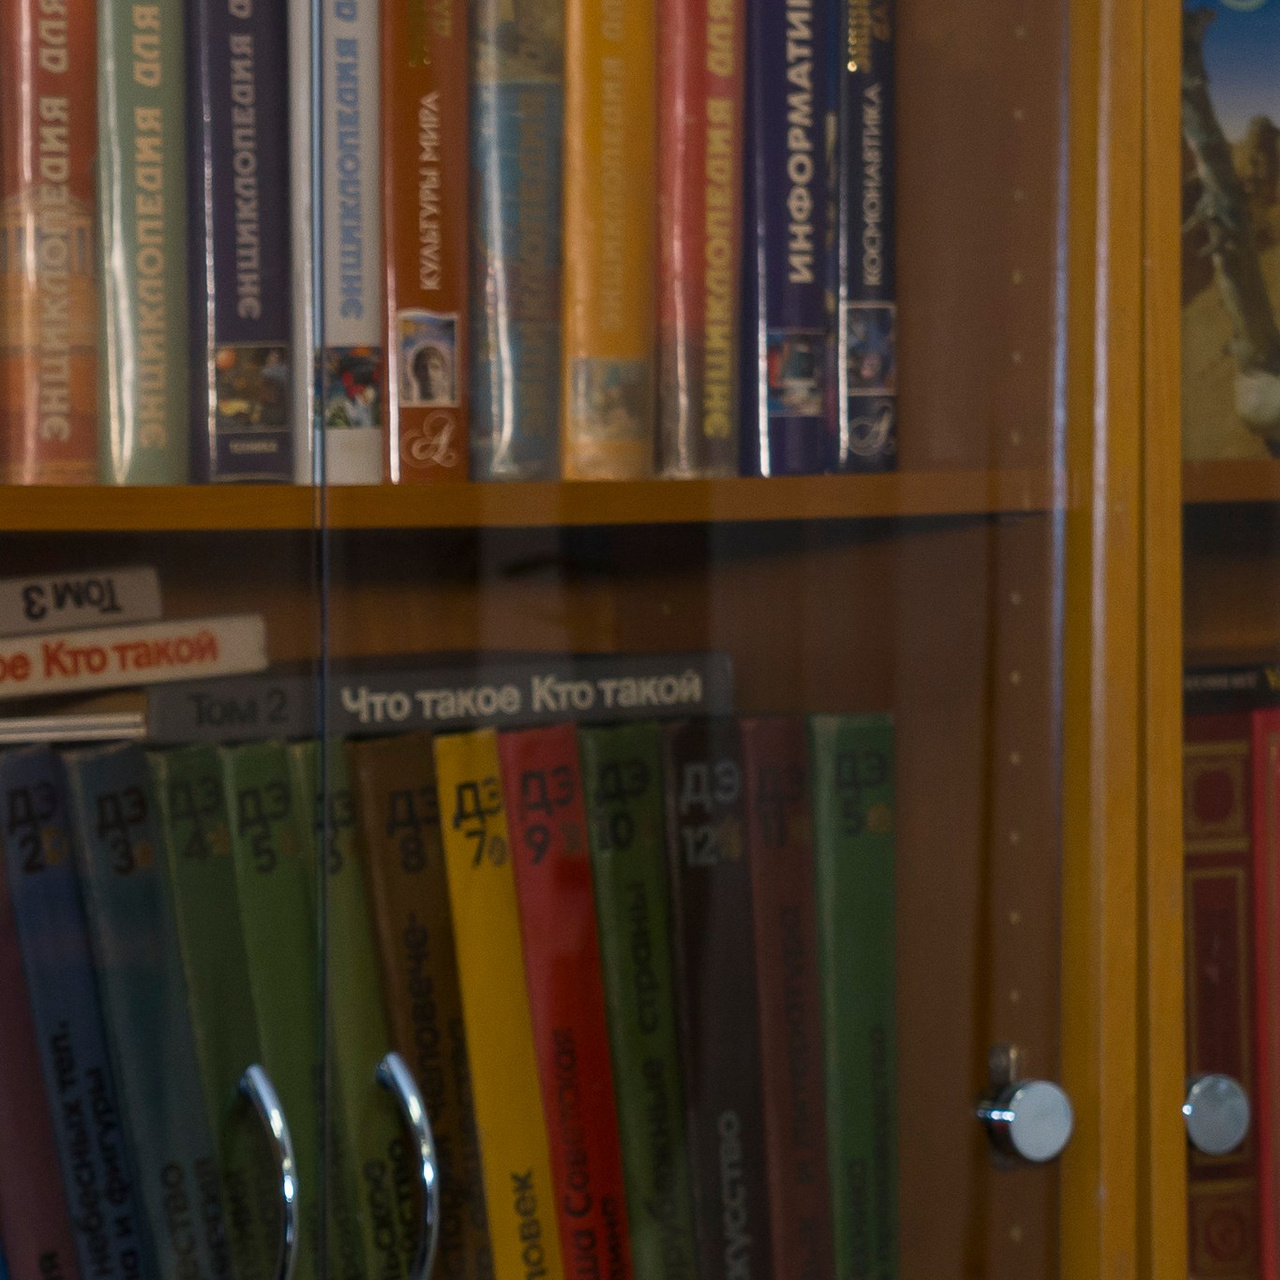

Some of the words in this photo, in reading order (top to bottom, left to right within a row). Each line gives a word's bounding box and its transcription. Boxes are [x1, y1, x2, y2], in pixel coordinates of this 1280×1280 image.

[132, 3, 163, 88] ДЛЯ
[420, 89, 442, 164] МИРА
[229, 33, 262, 322] ЭНЦИКЛОПЕДИЯ
[334, 37, 365, 322] ЭНЦИКЛОПЕДИЯ
[861, 82, 884, 287] КОСМОНАВТИКА
[39, 97, 71, 443] ЭНЦИКЛОПЕДИЯ
[419, 170, 443, 292] КУЛЬТУРЫ
[704, 98, 734, 438] ЭНЦИКЛОПЕДИЯ
[134, 107, 168, 452] ЭНЦИКЛОПЕДИЯ
[22, 583, 49, 622] 3
[49, 578, 124, 614] Том
[41, 639, 108, 678] Кто
[110, 629, 220, 670] такой
[267, 687, 291, 724] 2
[340, 684, 413, 725] Что
[413, 685, 524, 719] такое
[528, 673, 598, 714] Кто
[596, 667, 704, 709] такой
[22, 834, 45, 875] 2
[111, 835, 137, 876] 3
[251, 833, 279, 875] 5
[465, 826, 488, 868] 7
[524, 824, 552, 867] 9
[681, 825, 719, 867] 12
[626, 880, 659, 1036] страны
[85, 1066, 137, 1211] фигуры
[551, 1026, 594, 1218] Советская
[63, 1097, 113, 1278] небесных
